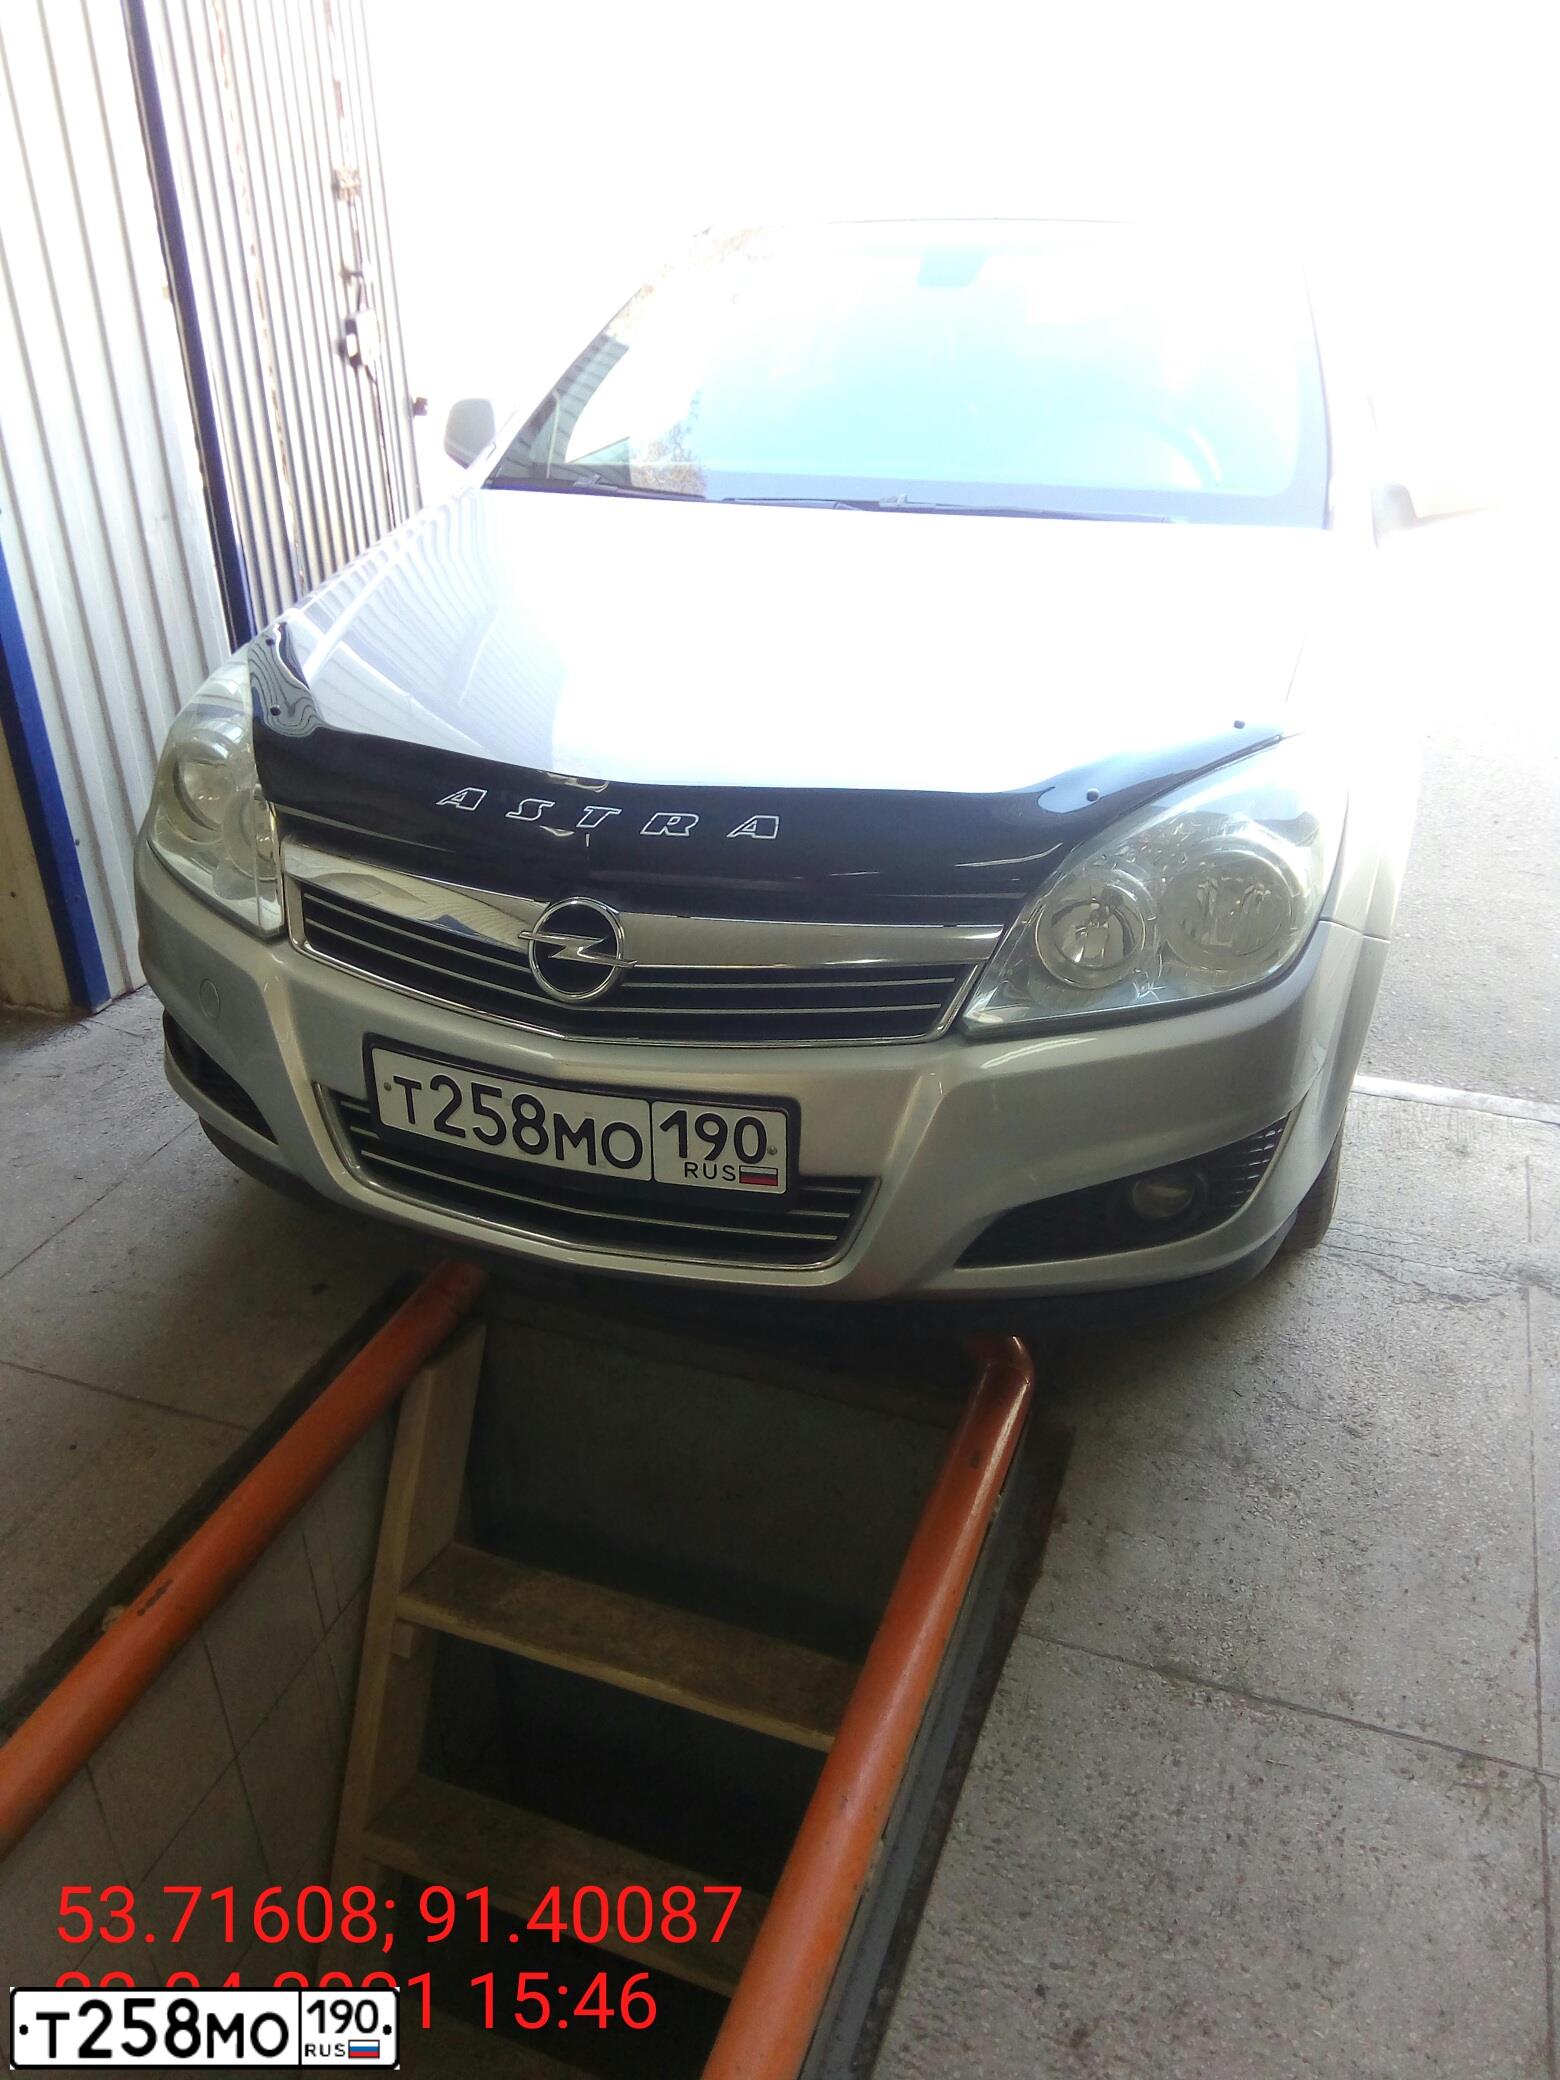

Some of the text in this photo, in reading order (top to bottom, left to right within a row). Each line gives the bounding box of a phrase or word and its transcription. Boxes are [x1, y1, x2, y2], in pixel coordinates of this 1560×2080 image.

[436, 787, 780, 839] ASTRA
[658, 1109, 768, 1165] 190
[684, 1162, 736, 1182] RUS
